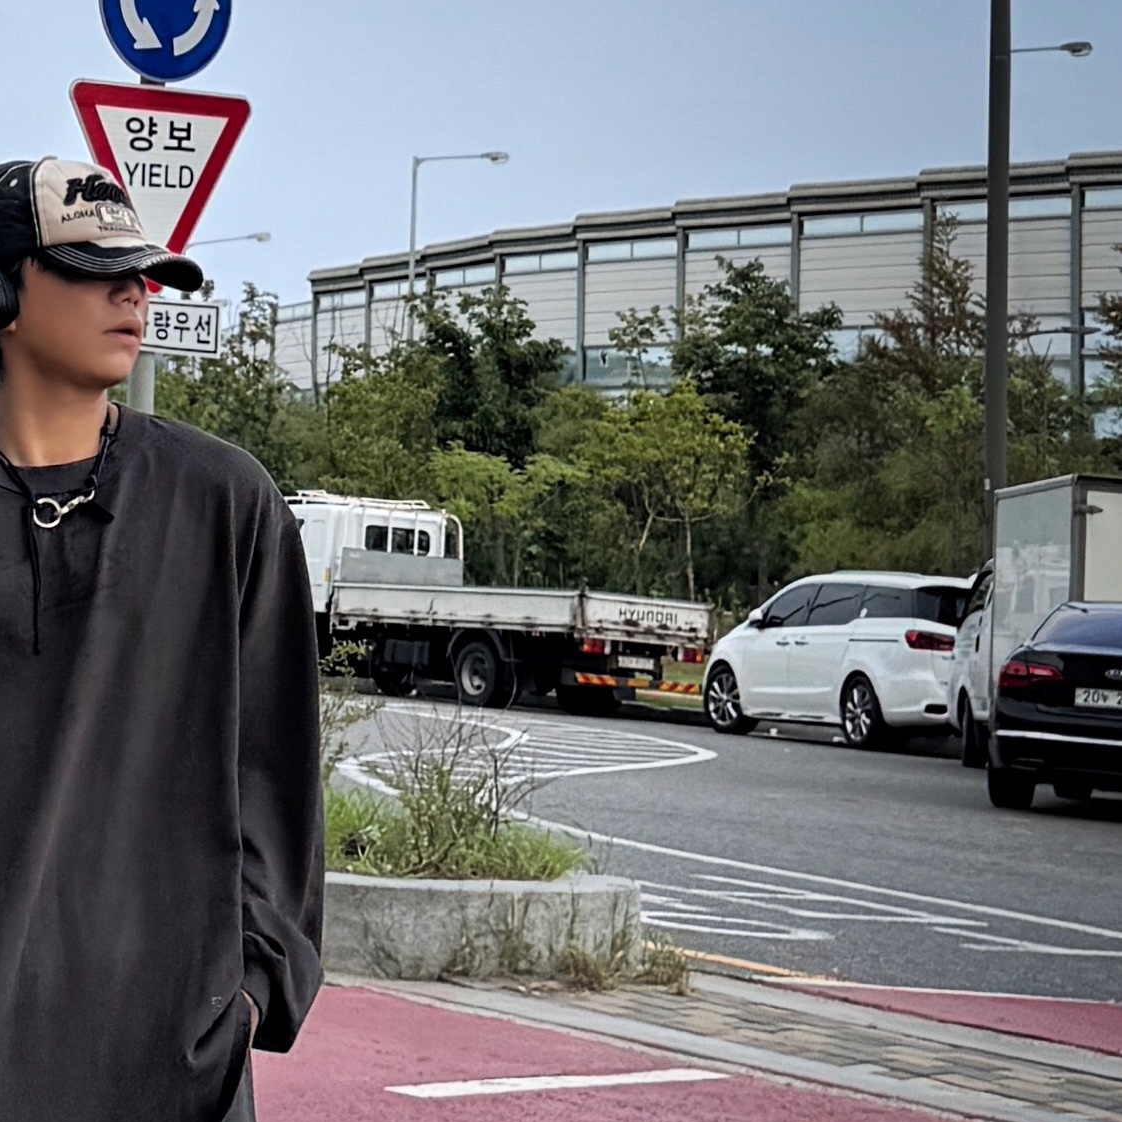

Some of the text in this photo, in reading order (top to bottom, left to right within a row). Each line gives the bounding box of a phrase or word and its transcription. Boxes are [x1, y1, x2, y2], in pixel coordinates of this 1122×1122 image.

[126, 116, 196, 152] 양보
[124, 161, 194, 188] YIELD
[619, 608, 678, 625] HYUNDAI
